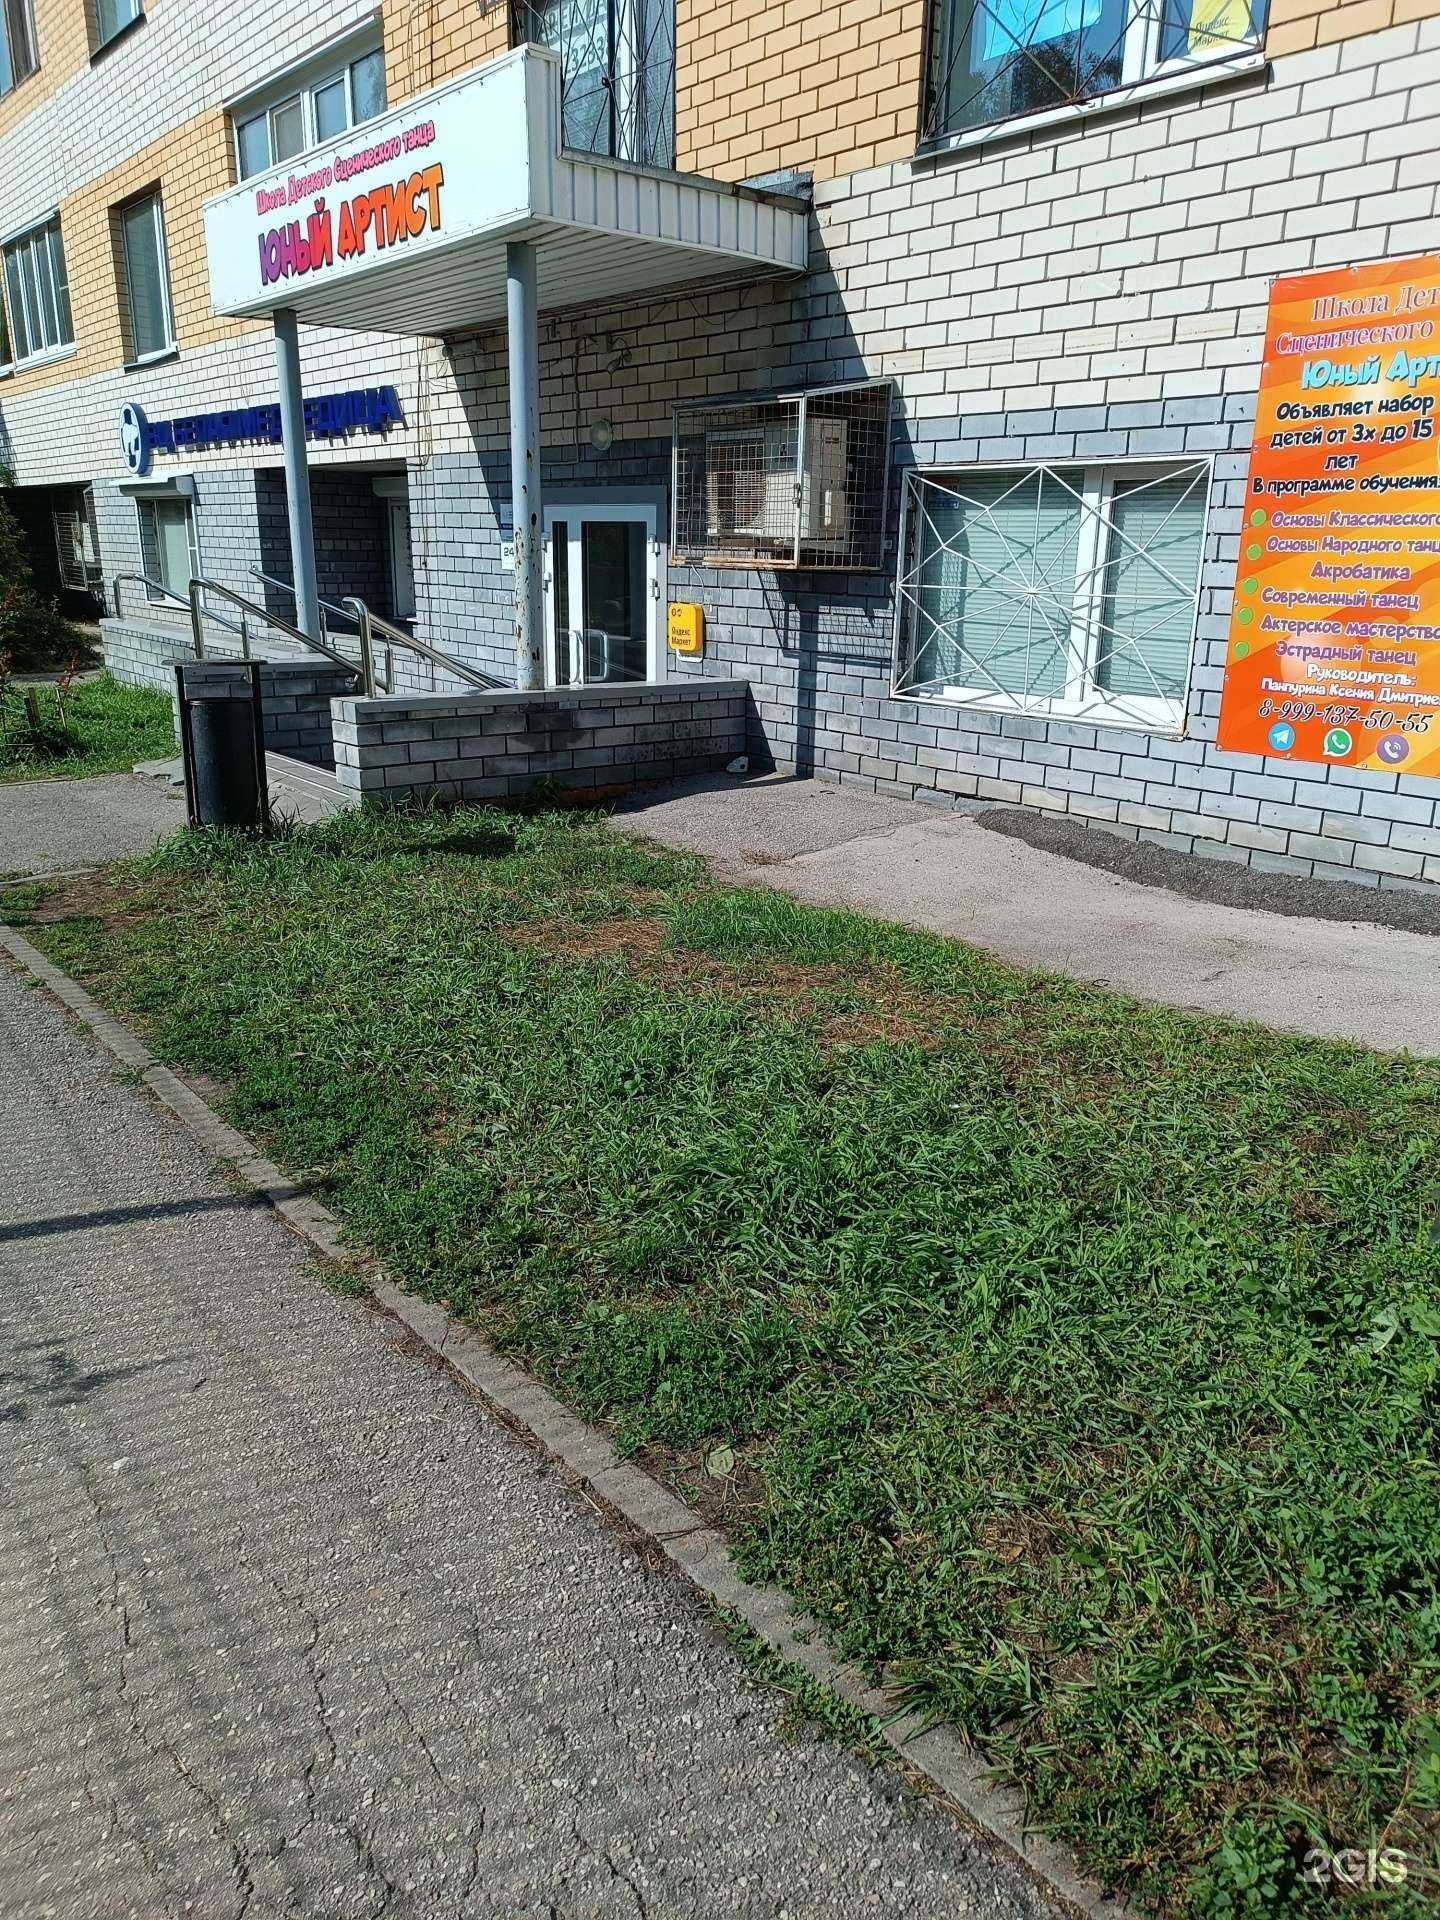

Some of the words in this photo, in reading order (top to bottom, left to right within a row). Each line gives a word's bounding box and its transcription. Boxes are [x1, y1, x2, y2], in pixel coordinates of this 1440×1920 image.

[256, 188, 287, 215] Школа
[288, 166, 332, 205] Детского
[334, 136, 401, 182] Сценического
[402, 120, 436, 153] танца
[258, 197, 333, 286] ЮНЫЙ
[338, 162, 444, 260] АРТИСТ
[1311, 294, 1389, 321] Школа
[1276, 320, 1433, 356] Сценического
[1301, 355, 1382, 391] Юный
[237, 385, 404, 443] МЕДЕДИЦА
[1276, 398, 1373, 420] Объявляет
[1377, 393, 1434, 416] набор
[1270, 425, 1323, 449] детей
[1327, 428, 1346, 443] от
[1352, 423, 1376, 441] 3х
[1380, 423, 1407, 443] до
[1411, 418, 1433, 439] 15
[1324, 455, 1358, 471] лет
[1252, 477, 1264, 494] В
[1267, 477, 1355, 498] программе
[1271, 511, 1325, 528] Основы
[1266, 537, 1318, 552] Основы
[1321, 536, 1402, 555] Народного
[1310, 561, 1411, 582] Акробатика
[1261, 587, 1366, 609] Современный
[1369, 593, 1420, 610] танец
[671, 626, 691, 637] Яндекс
[1260, 614, 1341, 635] Актерское
[671, 636, 691, 646] Маркет
[1275, 640, 1362, 663] Эстрадный
[1366, 647, 1416, 667] танец
[1306, 663, 1417, 687] Руководитель:
[1260, 676, 1326, 698] Панпурина
[1328, 684, 1375, 701] Ксения
[1258, 699, 1434, 734] 8-999-137-50-55
